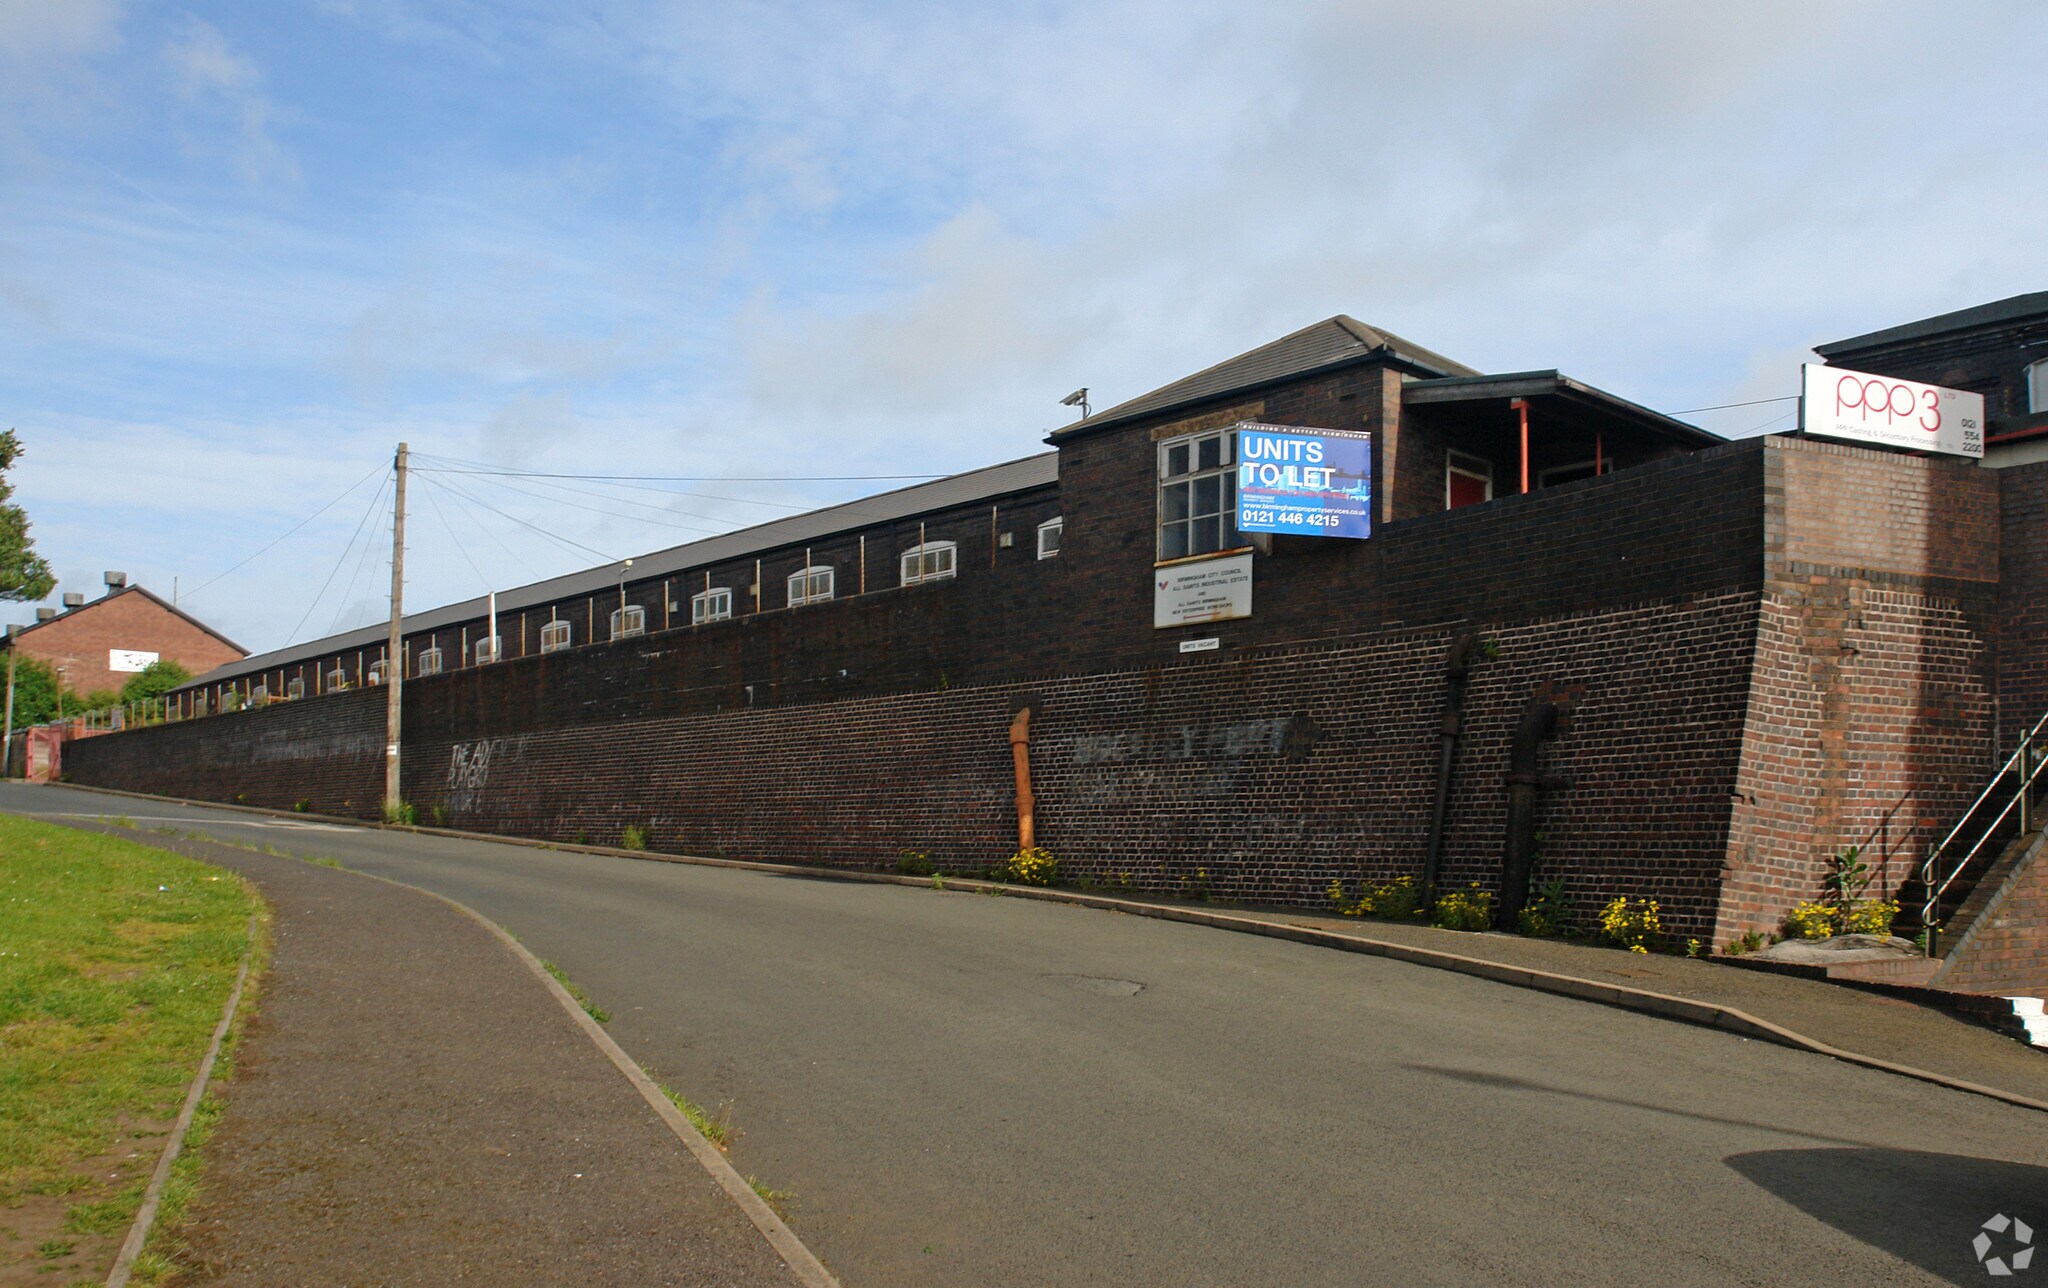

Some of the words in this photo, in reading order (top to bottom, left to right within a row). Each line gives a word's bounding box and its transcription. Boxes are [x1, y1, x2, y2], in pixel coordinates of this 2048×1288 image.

[1960, 418, 1977, 429] 0121
[1242, 424, 1279, 432] BUILDING
[1322, 431, 1368, 439] BIRMINGHAM
[1963, 430, 1980, 442] 554
[1244, 436, 1323, 463] UNITS
[1962, 441, 1982, 454] 2200
[1243, 461, 1281, 486] TO
[1288, 466, 1336, 488] LET
[1242, 509, 1274, 523] 0121
[1278, 511, 1303, 524] 446
[1306, 514, 1340, 527] 4215
[1177, 573, 1206, 583] BIRMINGHAM
[1220, 568, 1241, 576] COUNCIL
[1201, 579, 1228, 587] INDUSTRIAL
[1230, 575, 1248, 583] ESTATE
[1198, 640, 1217, 648] VACANT
